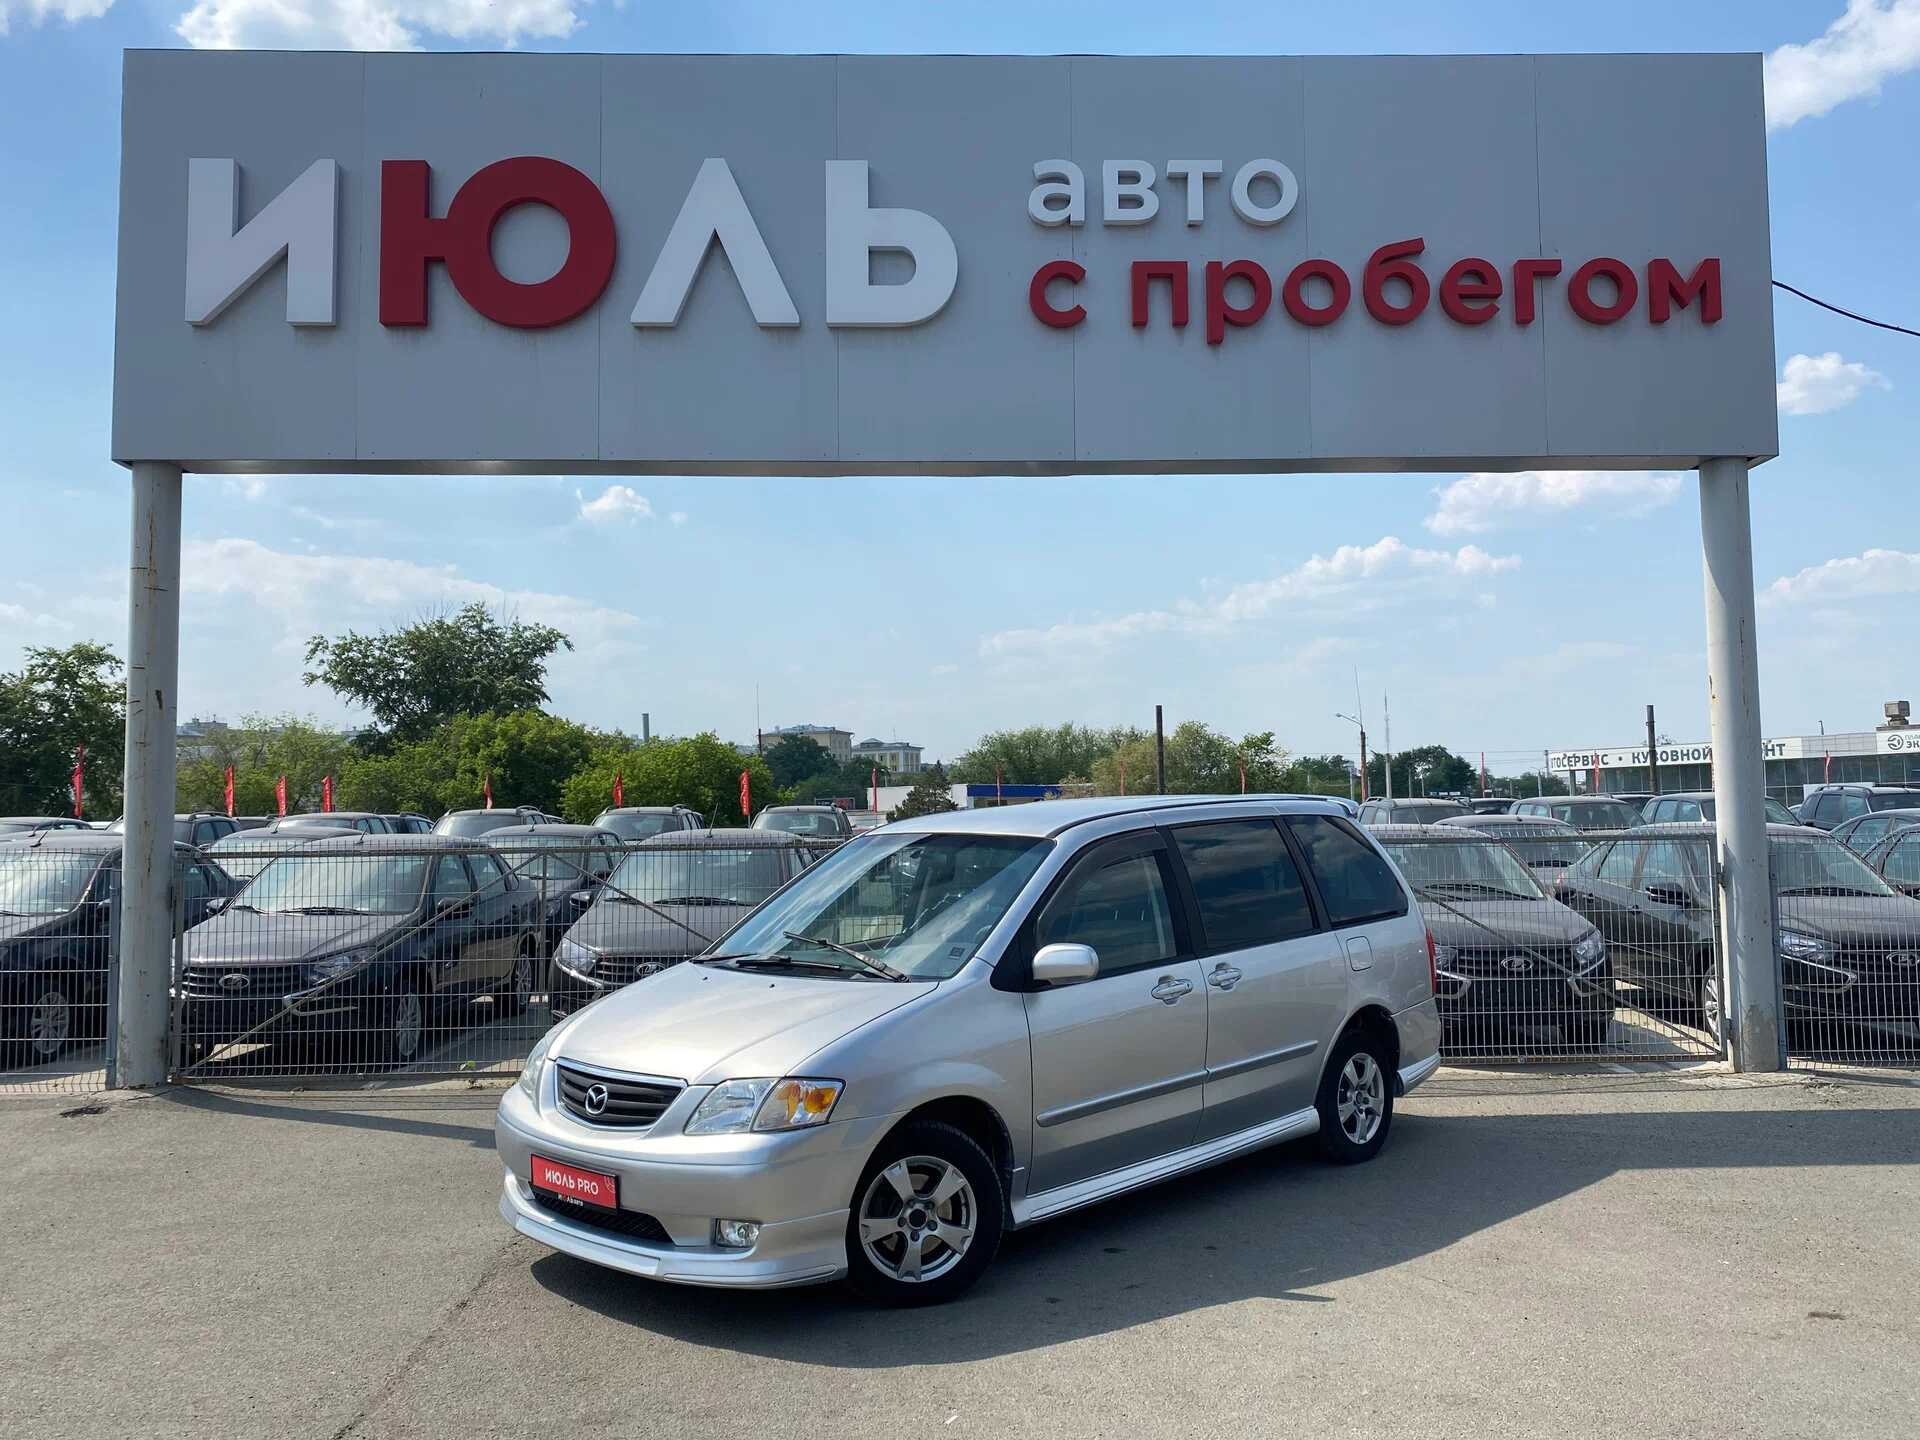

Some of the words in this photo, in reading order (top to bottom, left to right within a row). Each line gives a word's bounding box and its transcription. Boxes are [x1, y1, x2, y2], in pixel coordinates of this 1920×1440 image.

[1027, 158, 1299, 227] авто
[185, 155, 959, 328] ИЮЛЬ
[1029, 260, 1087, 329] с
[1131, 237, 1723, 345] пробегом
[545, 1168, 575, 1189] ИЮЛЬ
[577, 1178, 599, 1195] PRO
